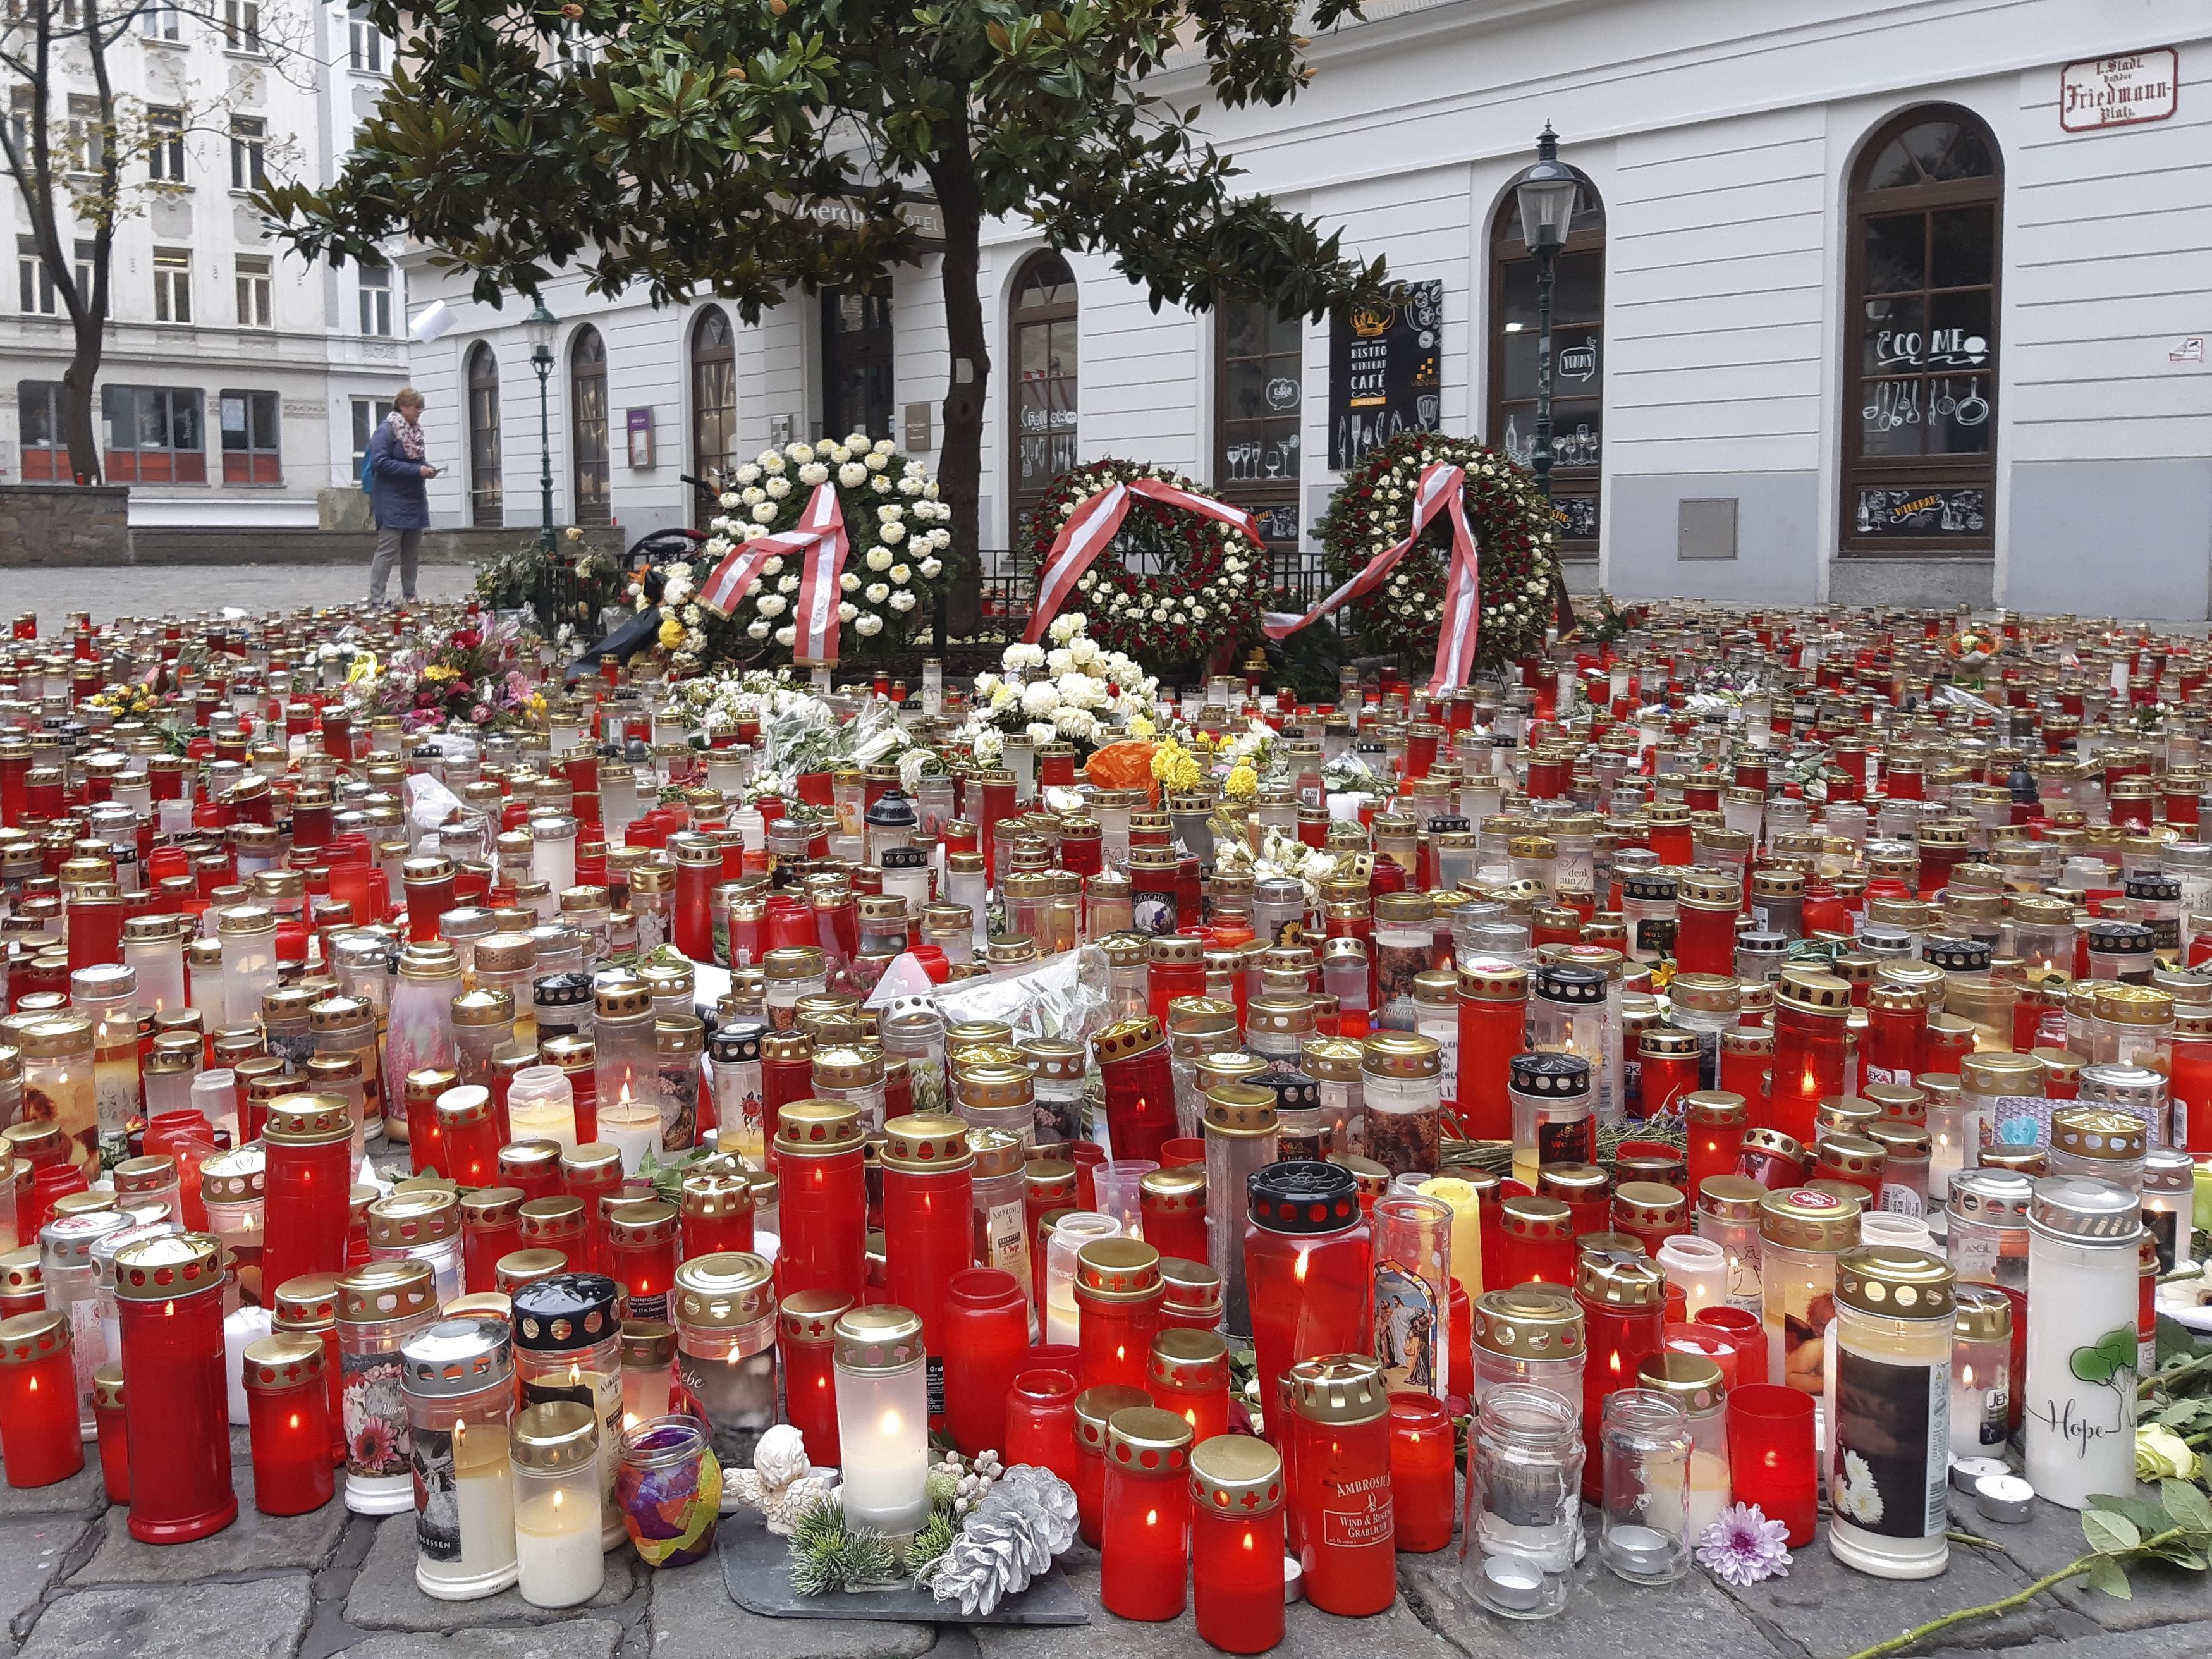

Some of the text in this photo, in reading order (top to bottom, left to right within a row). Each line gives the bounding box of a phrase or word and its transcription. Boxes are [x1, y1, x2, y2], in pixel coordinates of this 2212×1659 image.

[903, 214, 941, 231] OTEL
[1351, 346, 1387, 359] BISTRO
[1351, 359, 1386, 371] WINEBAR
[1350, 369, 1385, 389] CAFÉ
[1551, 509, 1568, 523] STRO
[1568, 869, 1588, 878] denk
[993, 1205, 1021, 1220] AMBROSIUS
[680, 1366, 706, 1388] iebe
[2047, 1399, 2106, 1459] Hope
[1336, 1471, 1391, 1497] AMBROSIUS
[1340, 1516, 1362, 1527] WIND
[1364, 1514, 1371, 1526] &
[1348, 1521, 1387, 1538] GRABLICHT
[418, 1533, 451, 1550] GESSEN
